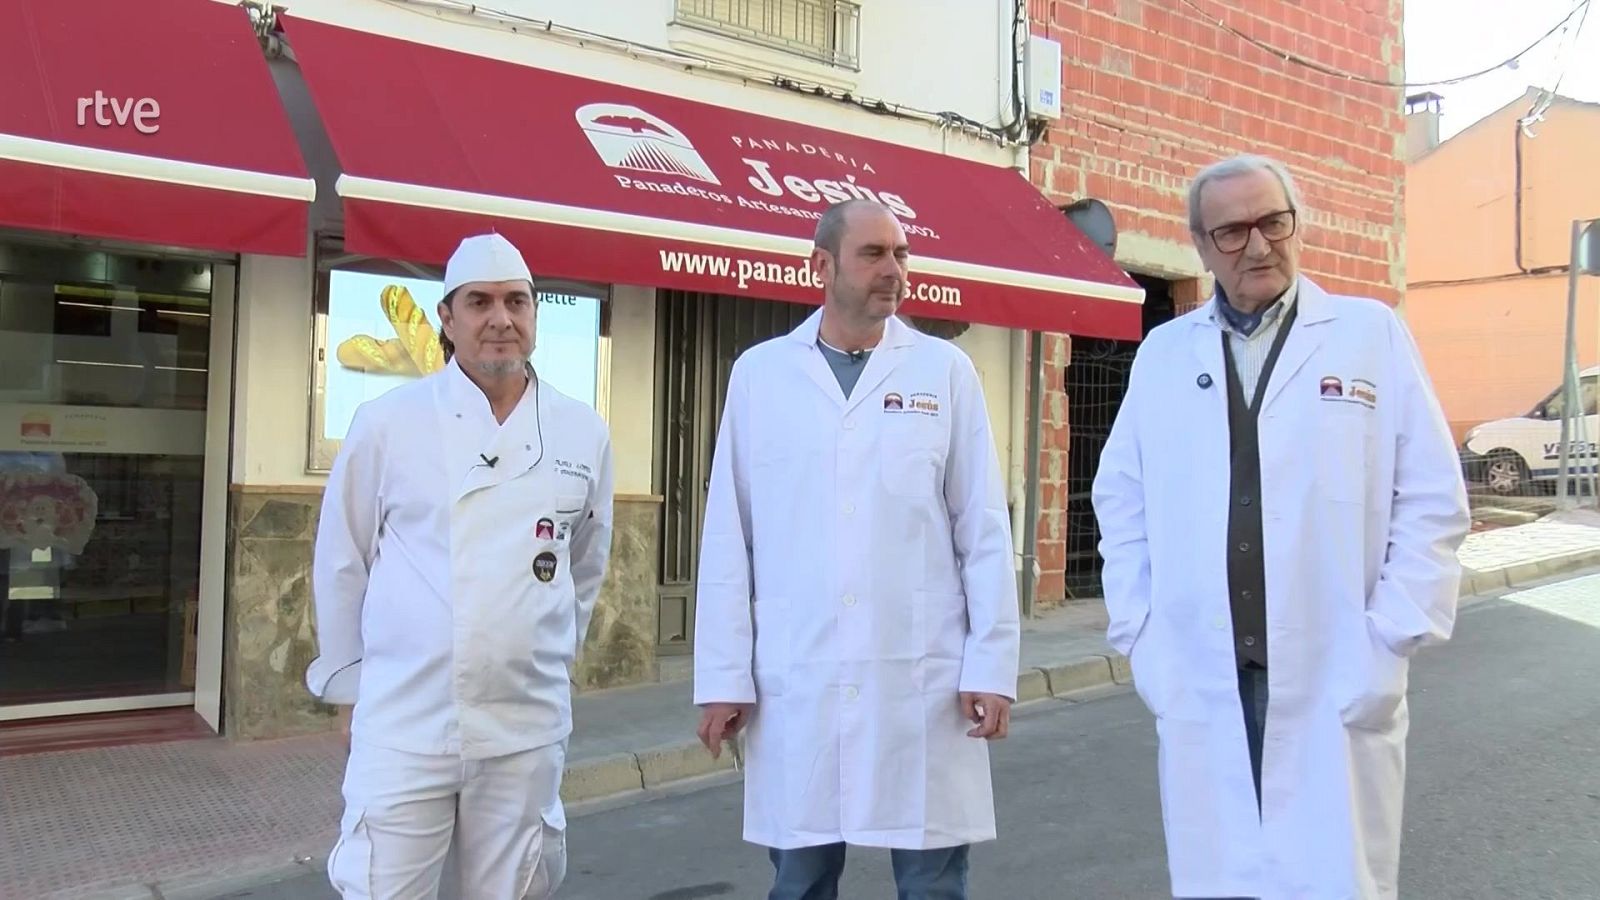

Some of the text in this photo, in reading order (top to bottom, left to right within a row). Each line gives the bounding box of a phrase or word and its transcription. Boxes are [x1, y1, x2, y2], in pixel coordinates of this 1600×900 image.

[614, 174, 940, 240] Panaderos Artesano 802
[741, 157, 917, 219] Jesús
